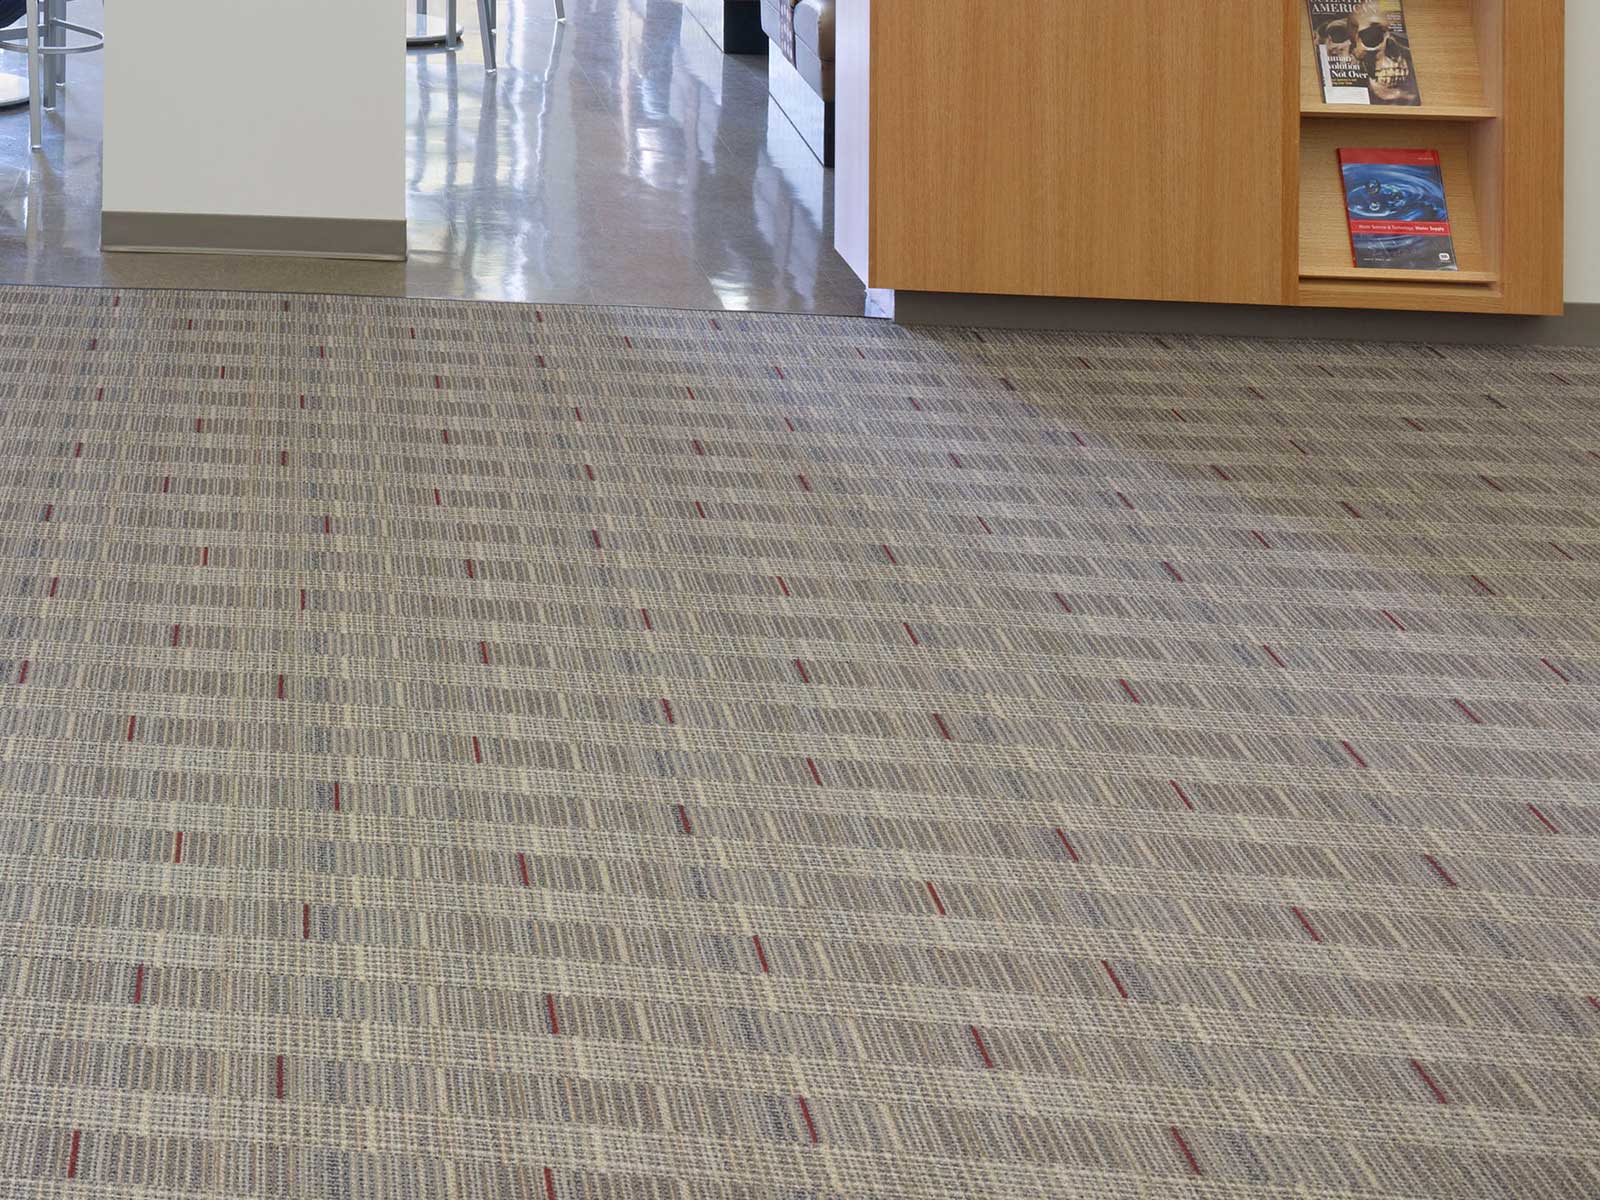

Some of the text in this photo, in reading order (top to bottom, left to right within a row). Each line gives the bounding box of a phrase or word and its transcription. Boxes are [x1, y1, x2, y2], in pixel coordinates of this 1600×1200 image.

[1312, 3, 1377, 14] AMERICAN
[1328, 62, 1360, 70] volution
[1332, 70, 1368, 79] Not Over
